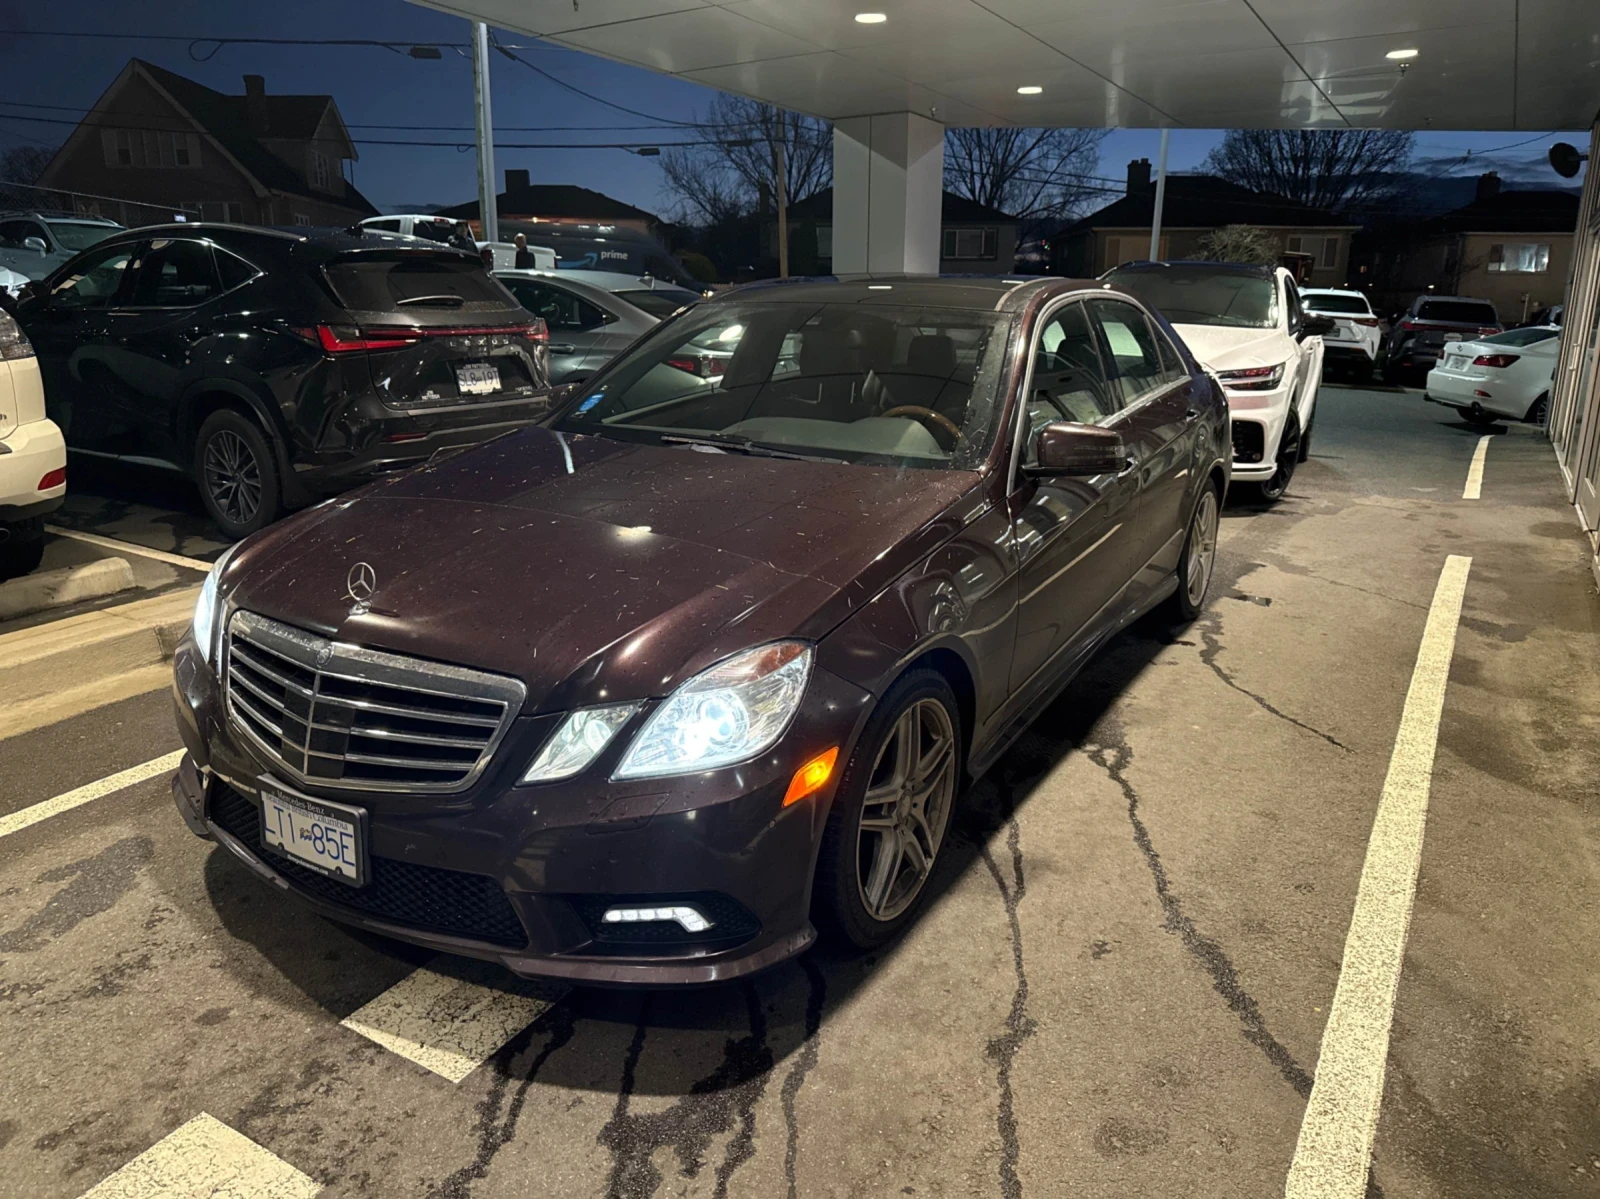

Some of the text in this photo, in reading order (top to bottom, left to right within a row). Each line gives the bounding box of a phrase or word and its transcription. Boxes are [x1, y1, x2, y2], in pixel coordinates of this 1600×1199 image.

[601, 250, 628, 260] prime
[450, 338, 509, 347] LEXUS
[313, 813, 348, 830] Columbia
[311, 823, 355, 867] 85E
